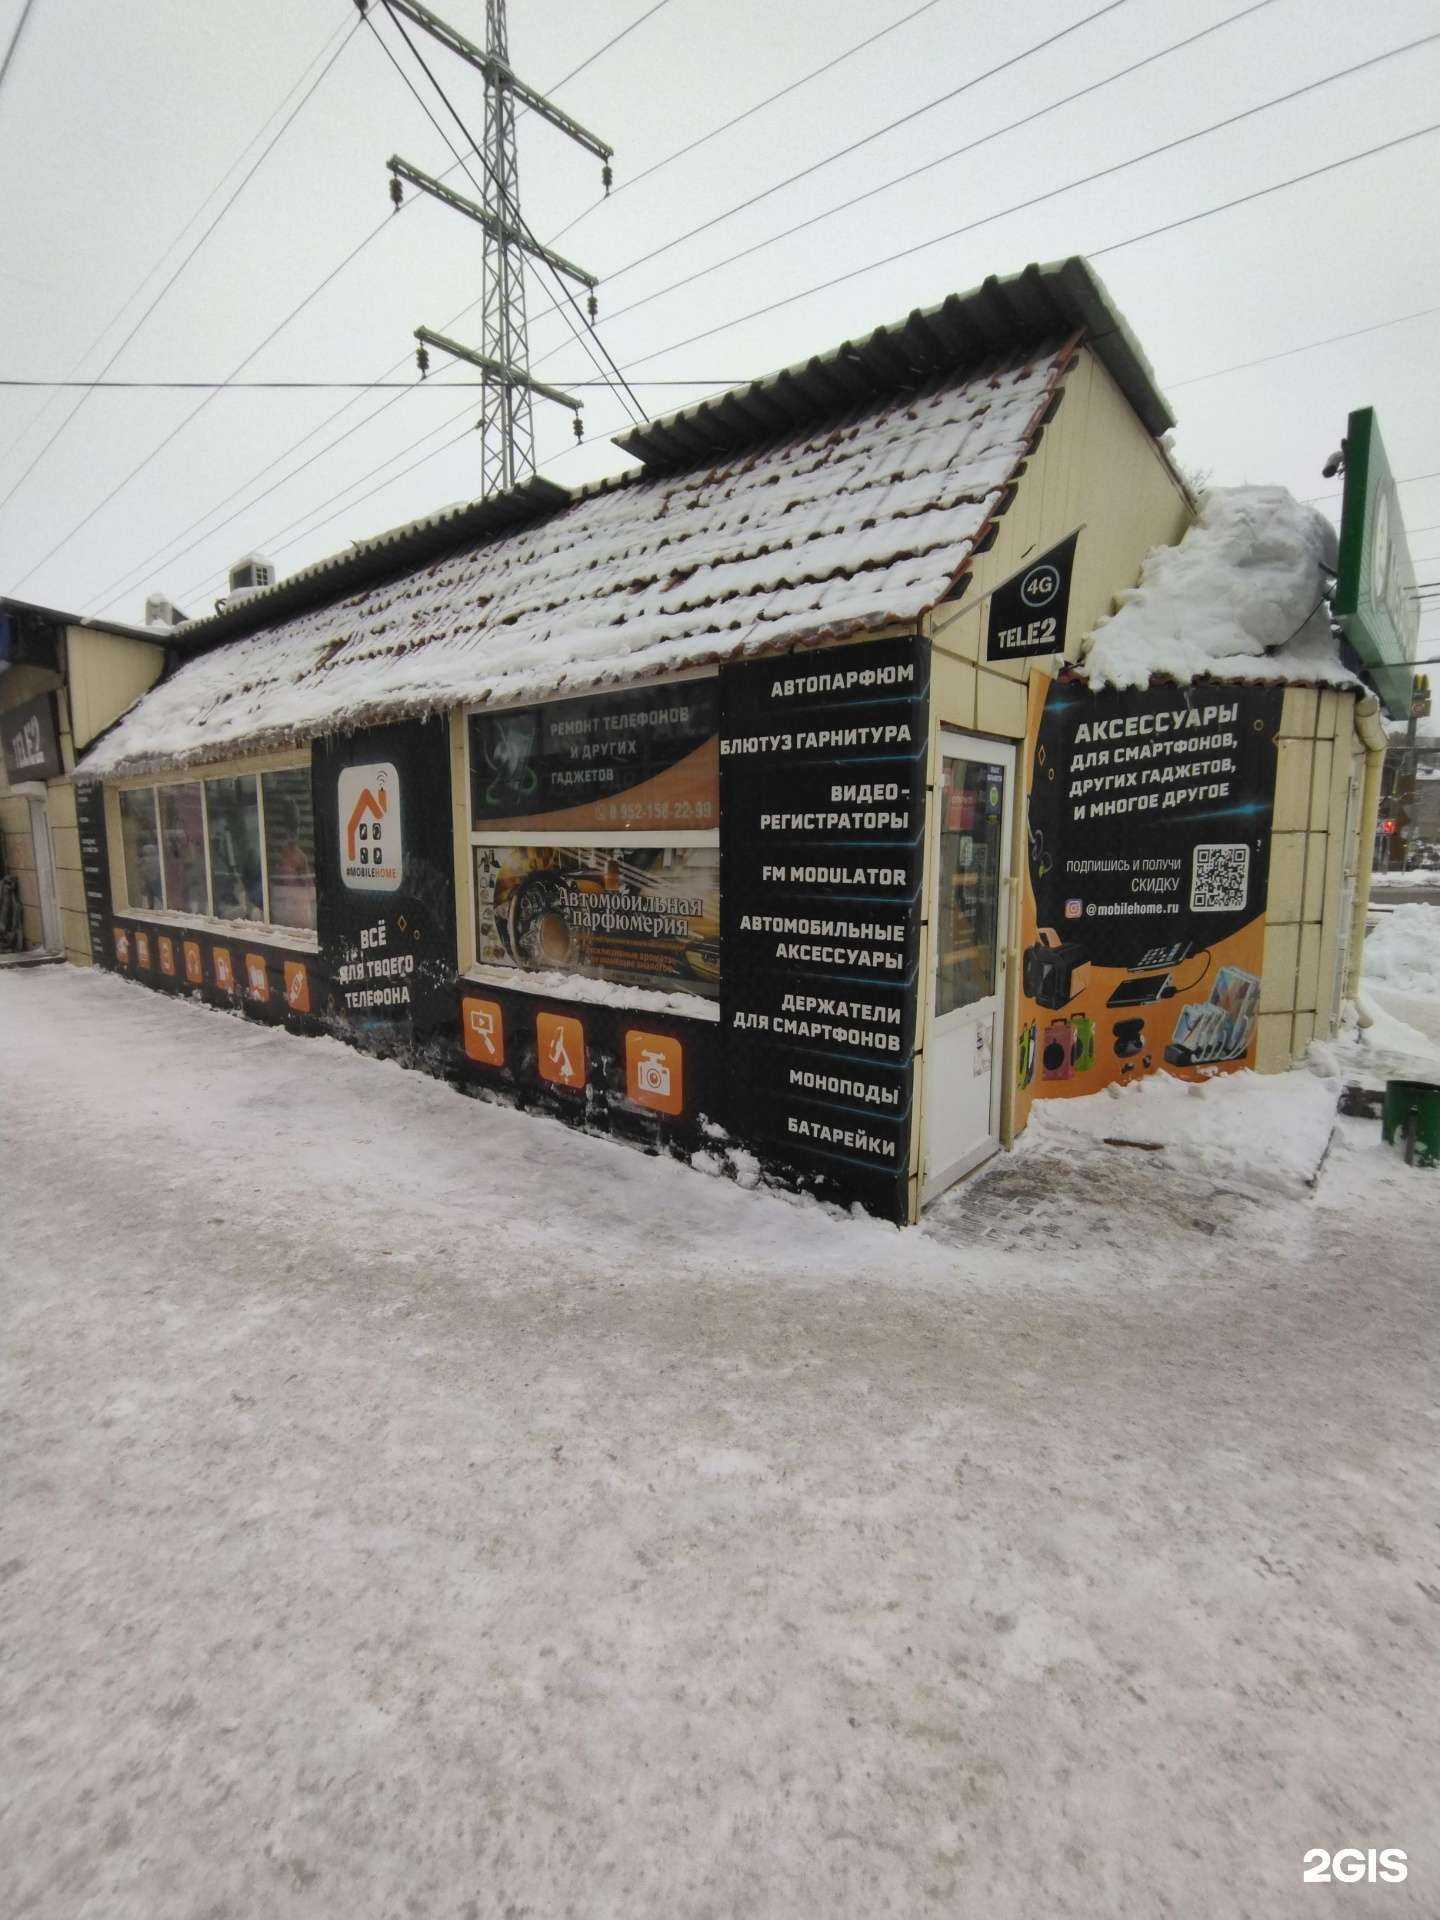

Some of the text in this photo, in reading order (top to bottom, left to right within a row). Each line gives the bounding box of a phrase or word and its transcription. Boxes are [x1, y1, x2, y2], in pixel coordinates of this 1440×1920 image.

[1027, 576, 1053, 595] 4G
[998, 617, 1057, 648] TELE2
[771, 664, 914, 698] АВТОПАРФЮМ
[550, 706, 690, 736] РЕМОНТ ТЕЛЕФОНОВ
[1074, 702, 1239, 744] АКСЕССУАРЫ
[570, 740, 637, 760] И ДРУГИХ
[720, 724, 912, 755] БЛЮТУЗ ГАРНИТУРА
[1070, 732, 1238, 772] ДЛЯ СМАРТФОНОВ,
[551, 768, 614, 786] ГАДЖЕТОВ
[1069, 758, 1237, 798] ДРУГИХ ГАДЖЕТОВ,
[1073, 782, 1230, 821] И МНОГОЕ ДРУГОЕ
[760, 812, 909, 830] РЕГИСТРАТОРЫ
[762, 866, 907, 886] FM MODULATOR
[1066, 858, 1181, 873] ПОДПИШИСЬ И ПОЛУЧИ
[1131, 877, 1180, 894] СКИДКУ
[559, 886, 704, 917] Автомобильная
[1086, 902, 1179, 916] @mobilehome.ru
[360, 919, 387, 950] ВСЁ
[573, 908, 689, 938] парфюмерия
[740, 915, 905, 942] АВТОМОБИЛЬНЫЕ
[339, 954, 414, 985] ДЛЯ ТВОЕГО
[775, 943, 903, 970] АКСЕССУАРЫ
[345, 985, 411, 1009] ТЕЛЕФОНА
[781, 994, 901, 1025] ДЕРЖАТЕЛИ
[733, 1011, 901, 1051] ДЛЯ СМАРТФОНОВ
[789, 1069, 899, 1105] МОНОПОДЫ
[788, 1117, 896, 1157] БАТАРЕЙКИ
